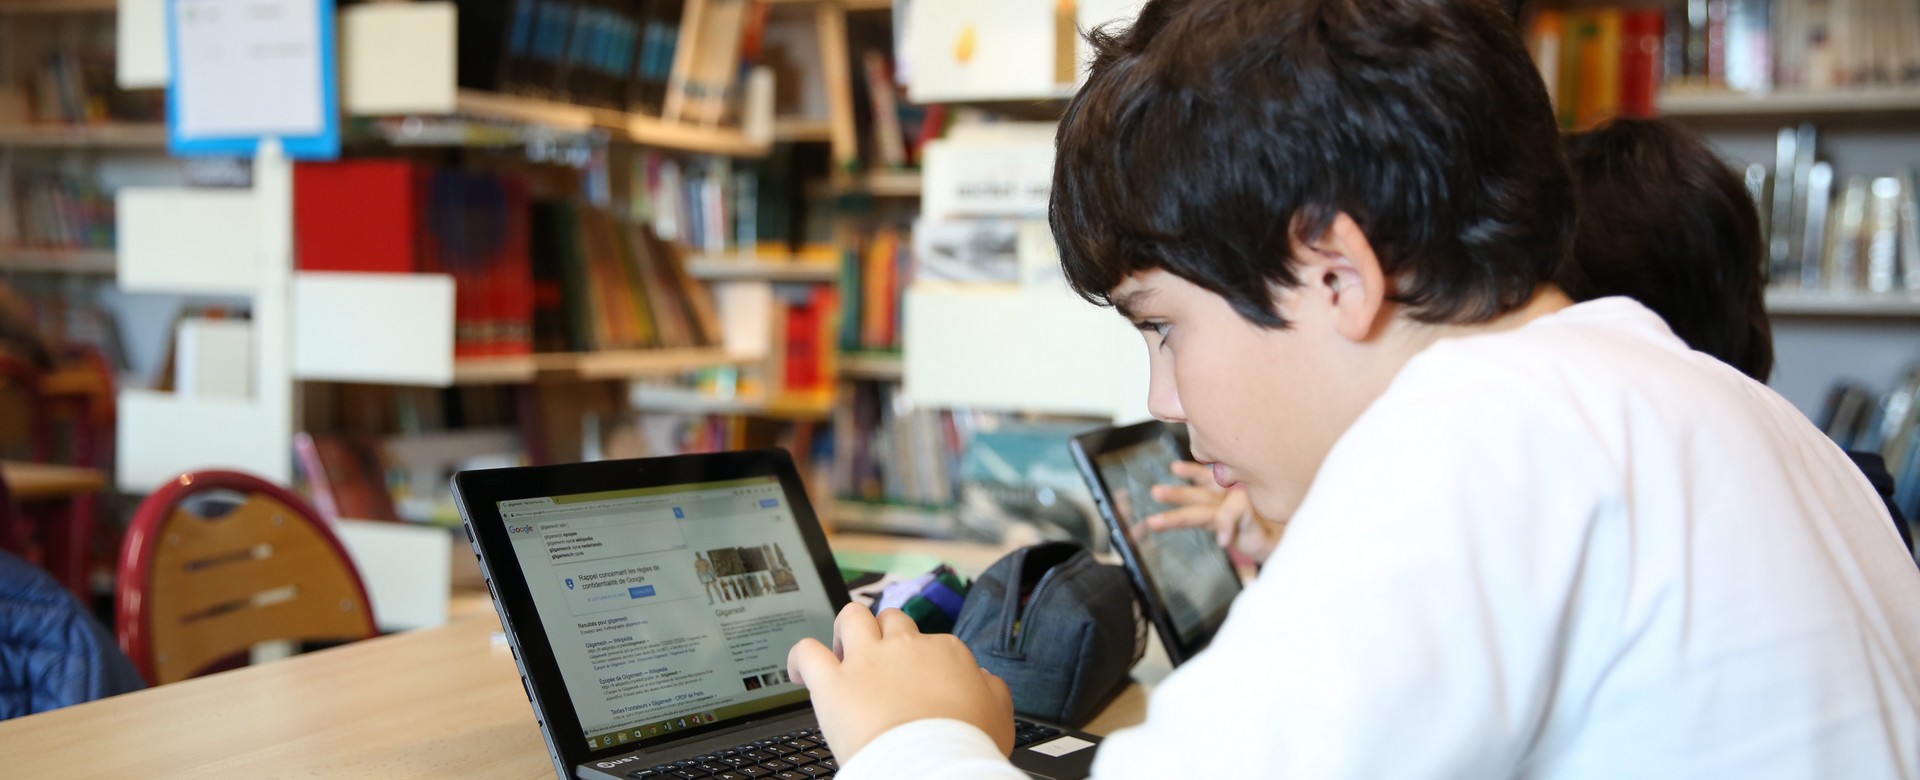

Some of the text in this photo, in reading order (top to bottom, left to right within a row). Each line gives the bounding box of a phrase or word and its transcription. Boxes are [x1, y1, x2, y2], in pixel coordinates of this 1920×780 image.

[508, 524, 534, 535] Google
[579, 573, 599, 581] Rappel
[599, 570, 628, 578] concernant
[637, 566, 653, 574] règles
[582, 579, 619, 589] confidentialité
[626, 575, 646, 584] Google
